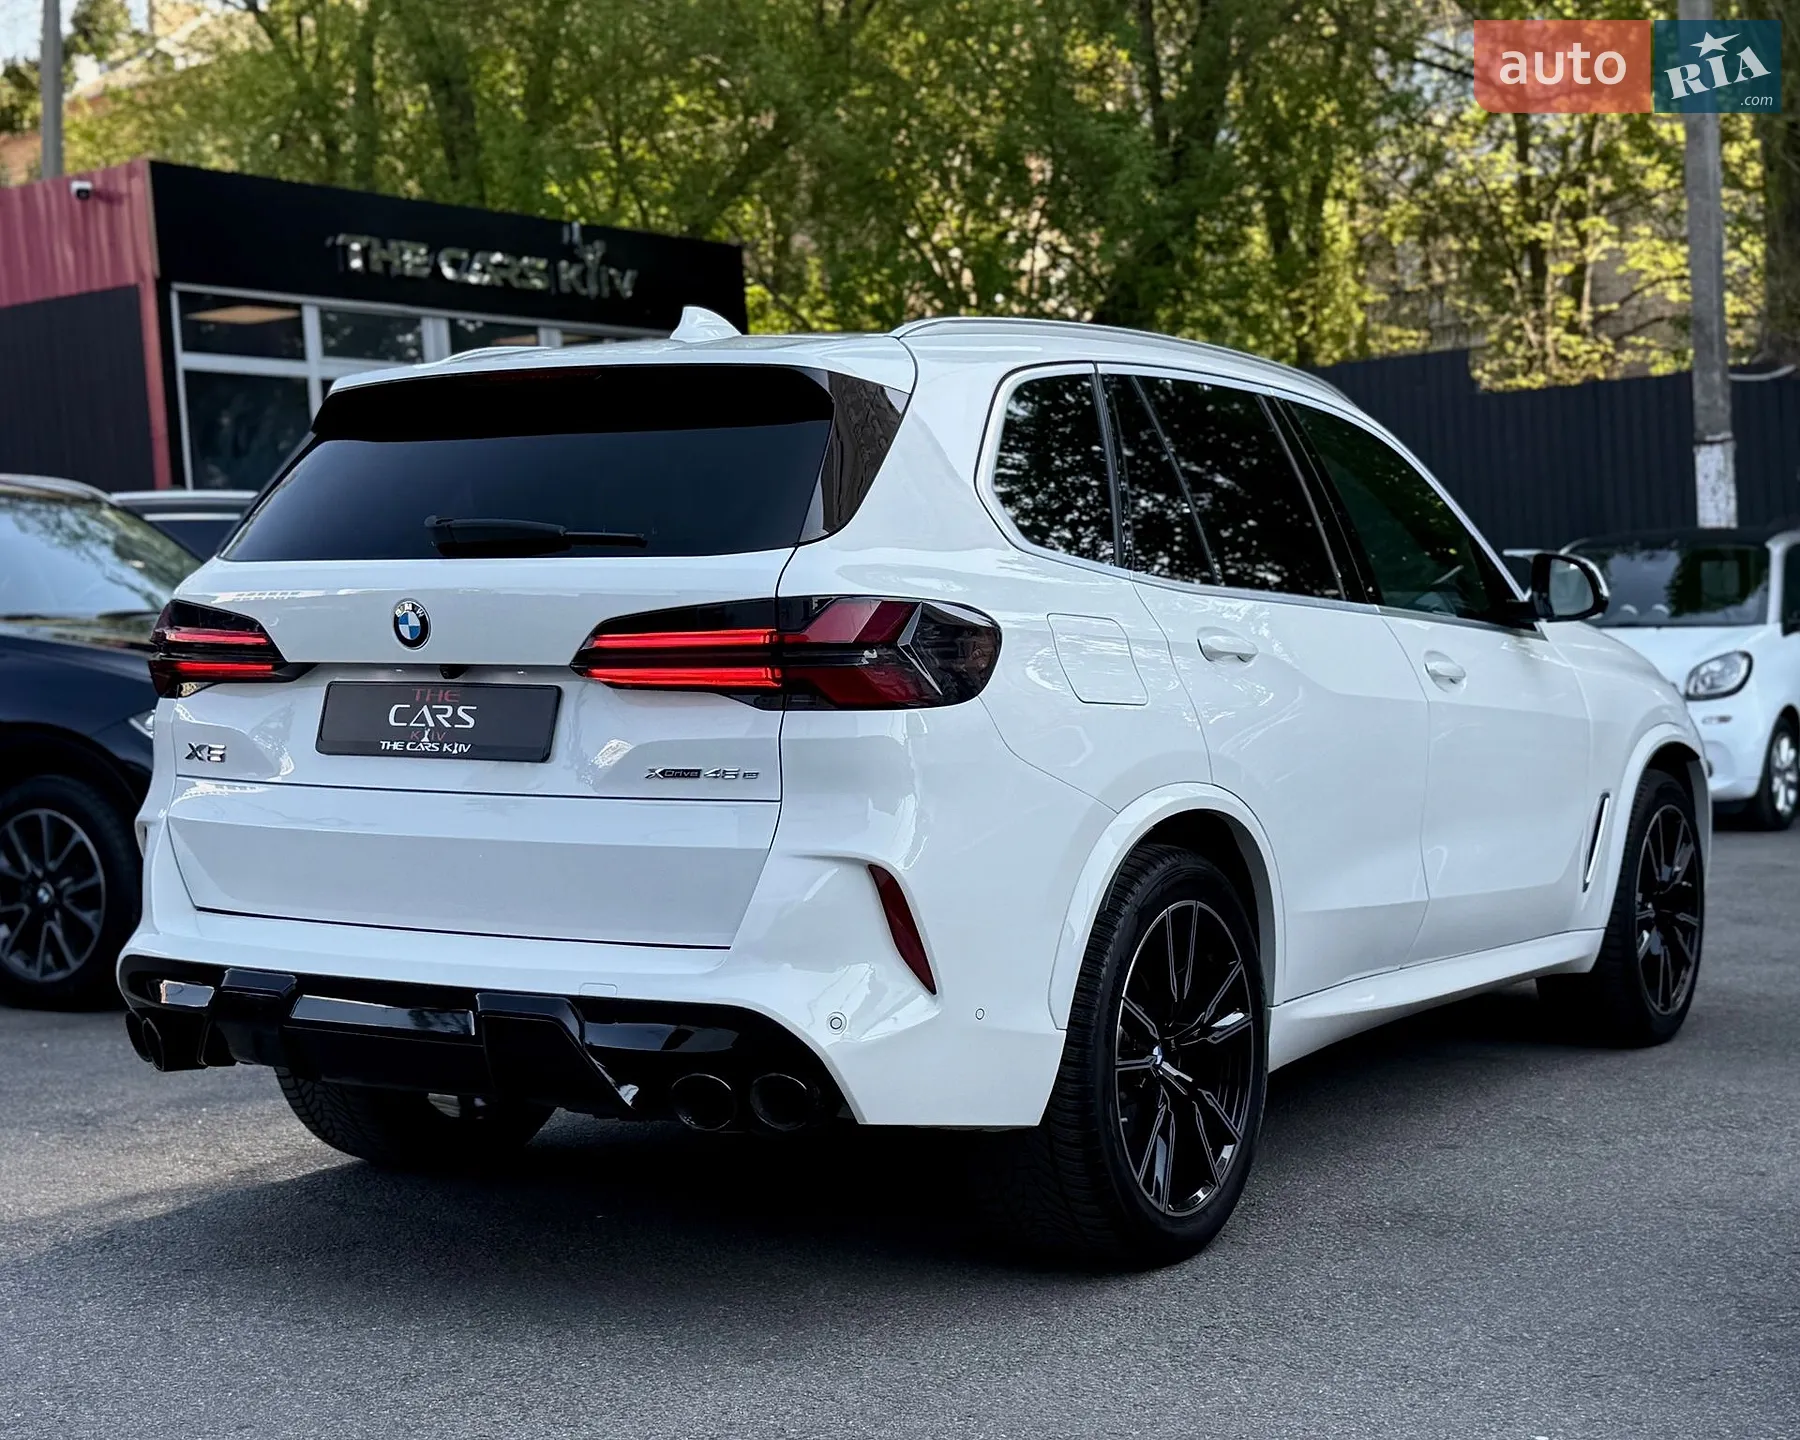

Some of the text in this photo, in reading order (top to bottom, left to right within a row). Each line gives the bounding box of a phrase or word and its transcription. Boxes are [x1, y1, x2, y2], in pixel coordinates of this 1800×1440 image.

[335, 233, 431, 278] THE
[438, 247, 549, 290] CARS
[411, 687, 461, 703] THE
[388, 704, 477, 728] CARS
[380, 740, 405, 751] THE
[406, 741, 440, 752] CARS
